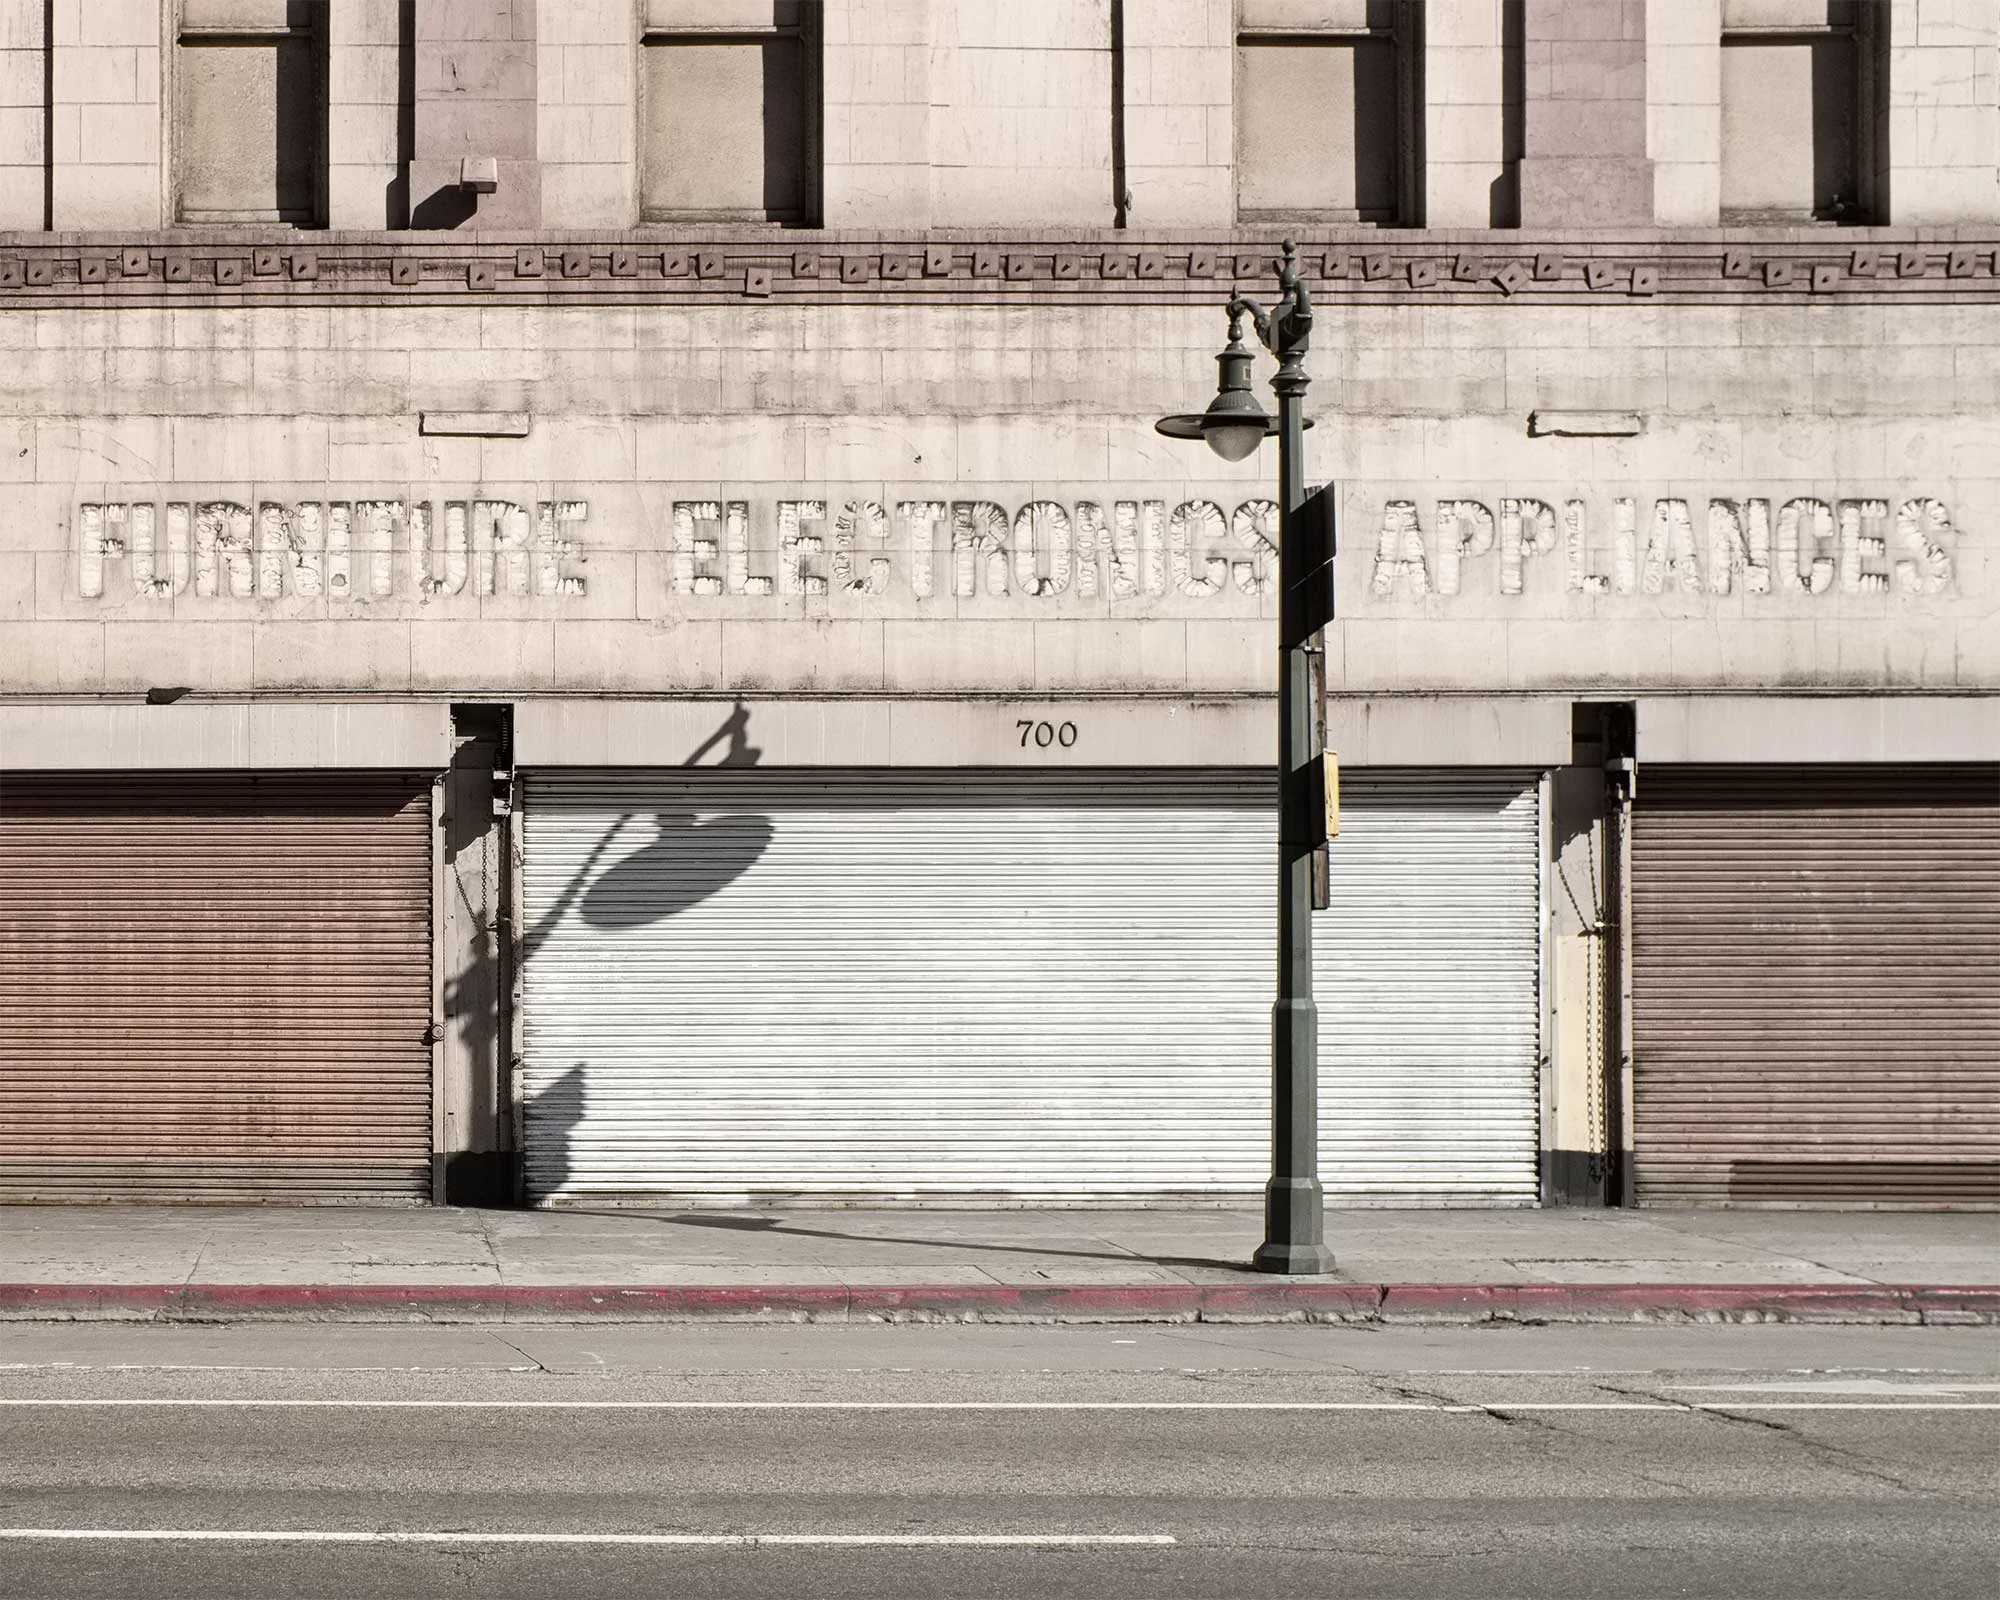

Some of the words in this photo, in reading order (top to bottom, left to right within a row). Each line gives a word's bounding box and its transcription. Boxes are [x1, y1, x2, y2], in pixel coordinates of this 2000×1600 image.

[79, 501, 588, 597] FURNITURE
[672, 499, 1279, 598] ELECTRONICS
[1372, 497, 1955, 596] APPLIANCES
[1016, 720, 1077, 747] 700
